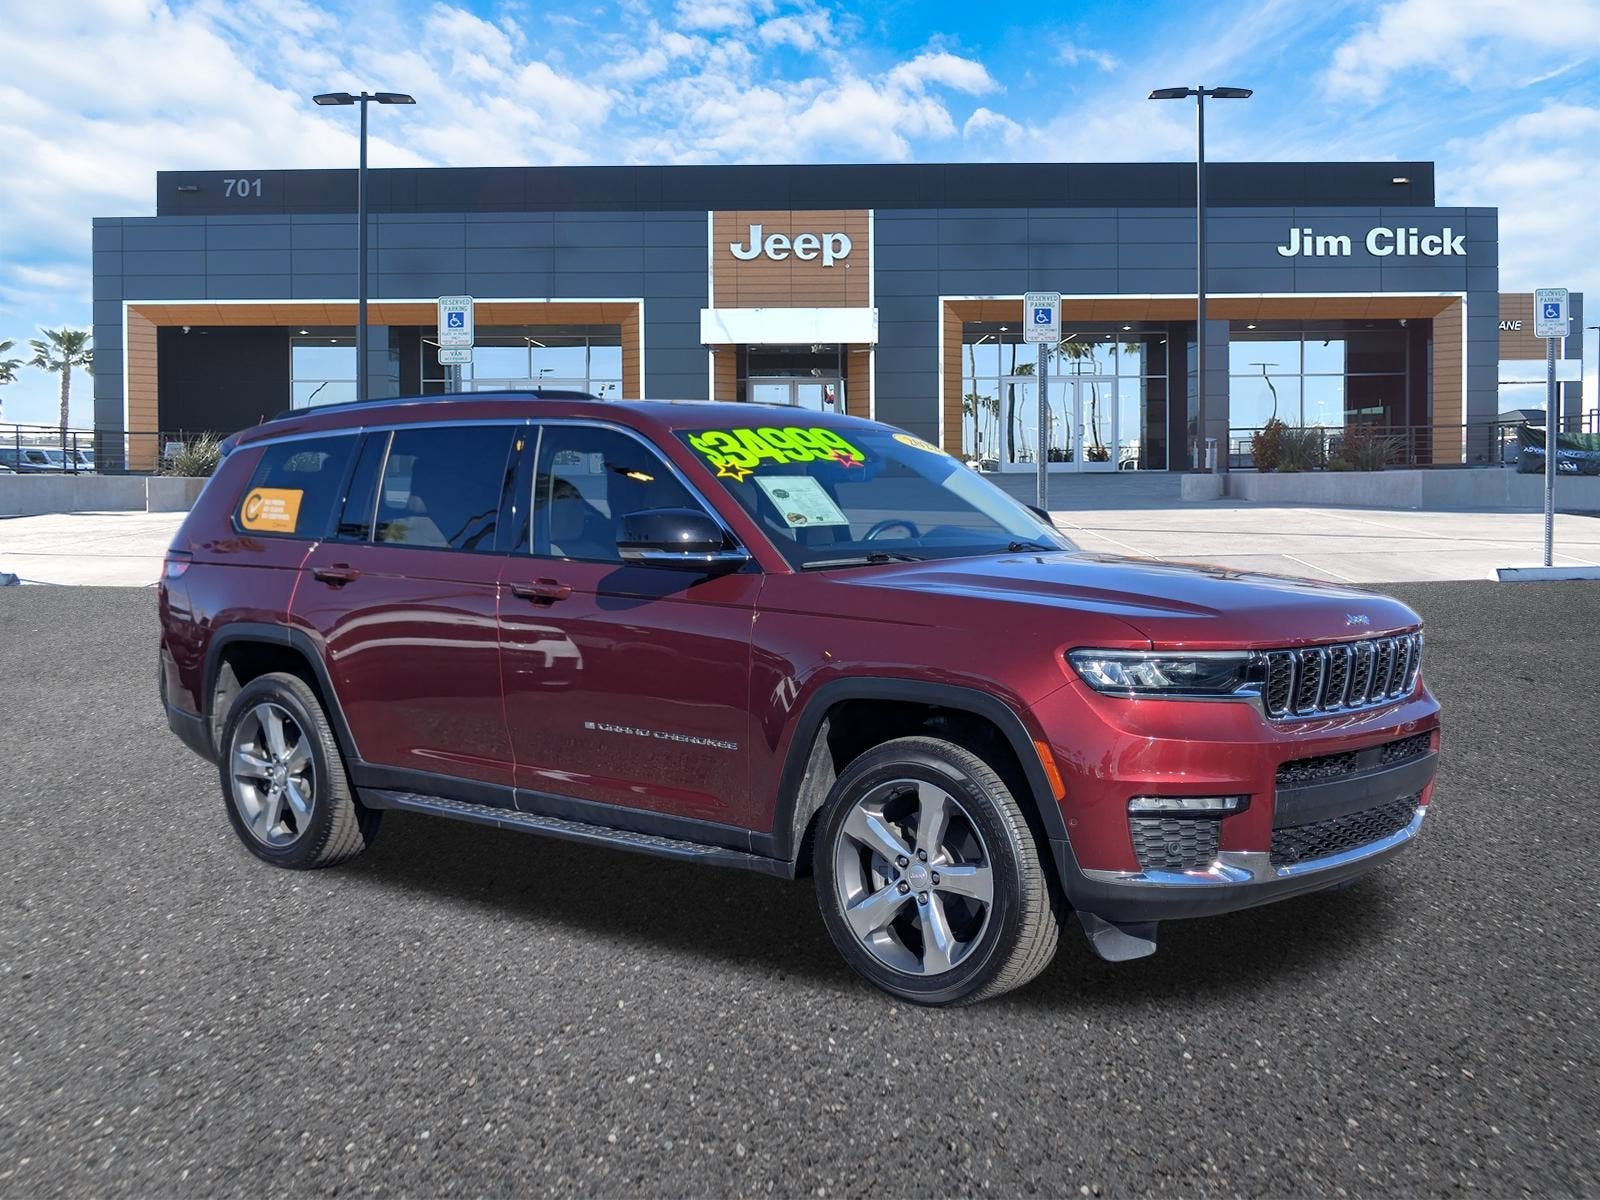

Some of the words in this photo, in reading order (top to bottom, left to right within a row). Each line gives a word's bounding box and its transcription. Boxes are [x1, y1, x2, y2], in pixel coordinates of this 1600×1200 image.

[223, 178, 262, 197] 701
[730, 224, 852, 267] Jeep
[1277, 228, 1352, 257] Jim
[1365, 227, 1467, 256] Click
[688, 427, 866, 468] $34999
[597, 722, 651, 737] GRAND
[653, 731, 738, 751] CHEROKEE
